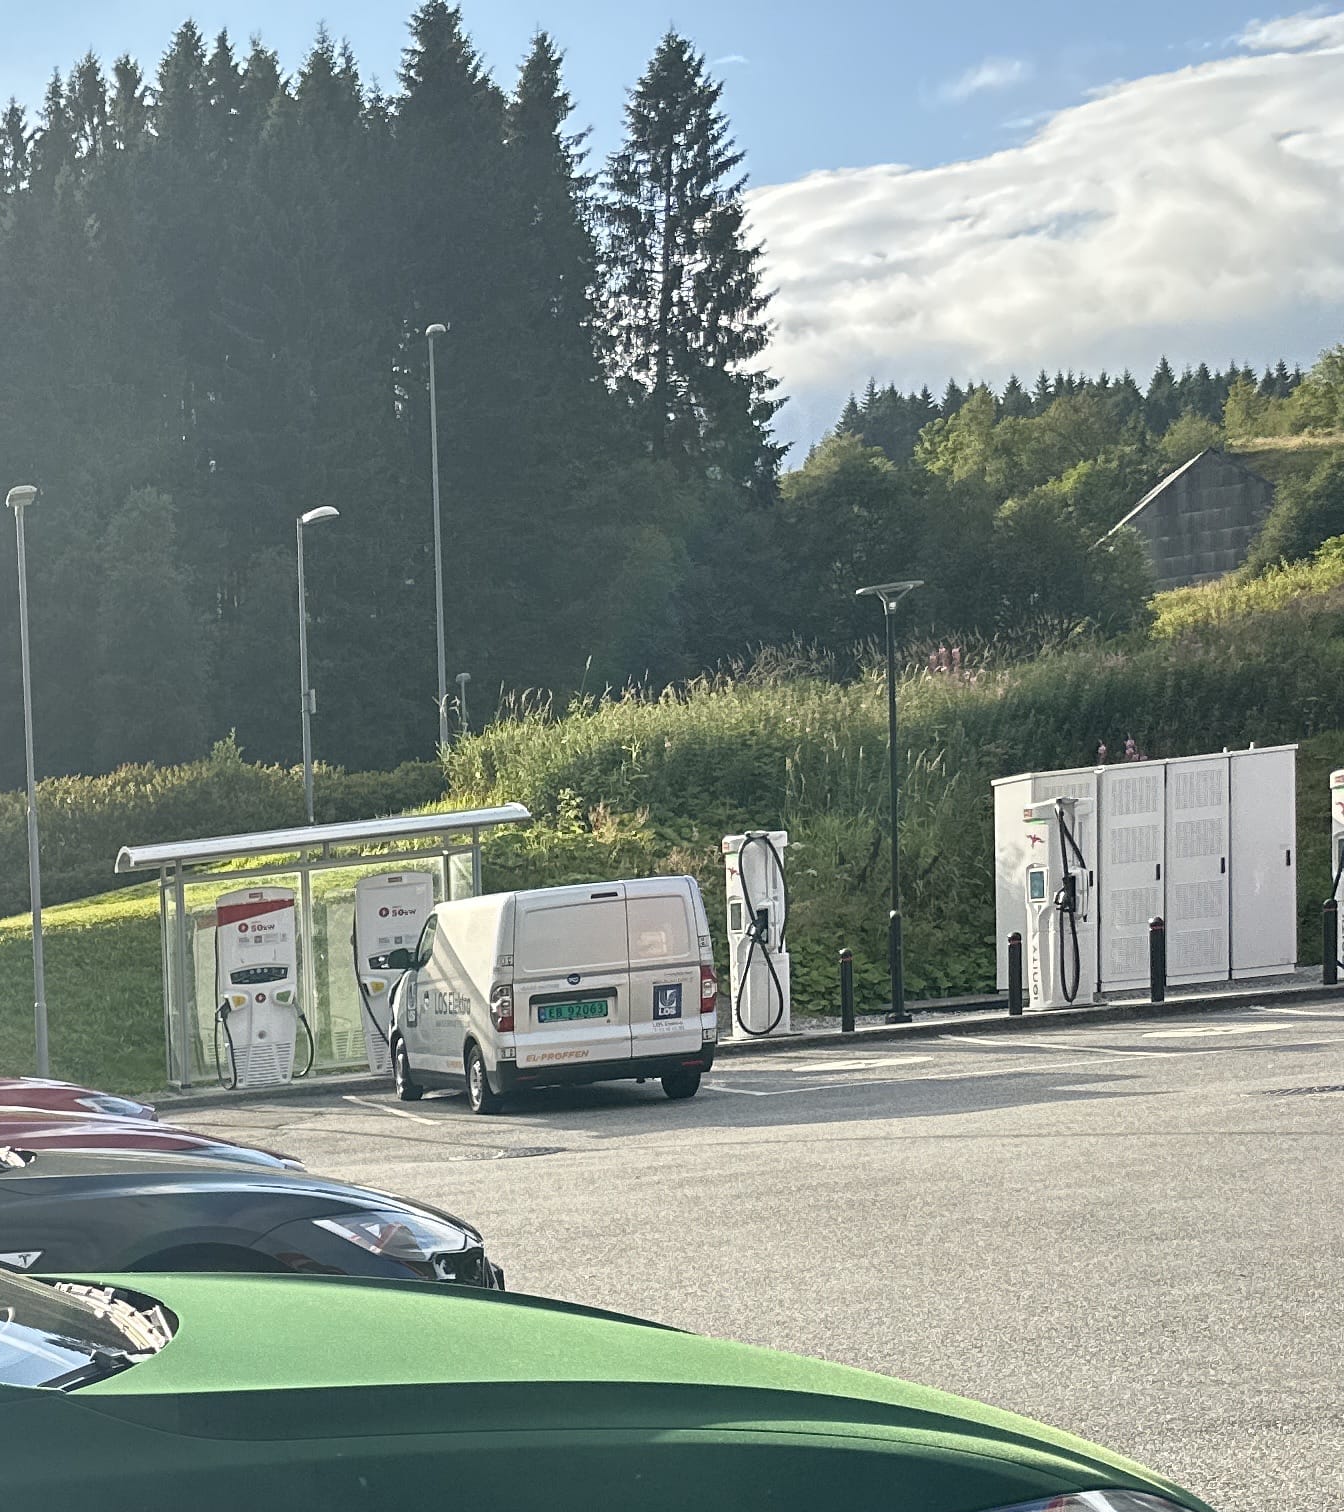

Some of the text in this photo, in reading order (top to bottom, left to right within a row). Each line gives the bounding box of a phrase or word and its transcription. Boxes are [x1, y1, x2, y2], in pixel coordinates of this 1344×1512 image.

[1031, 944, 1040, 1001] IONITY
[434, 991, 447, 1015] LOS
[549, 1003, 604, 1018] EB 92063
[658, 1007, 677, 1016] LOS
